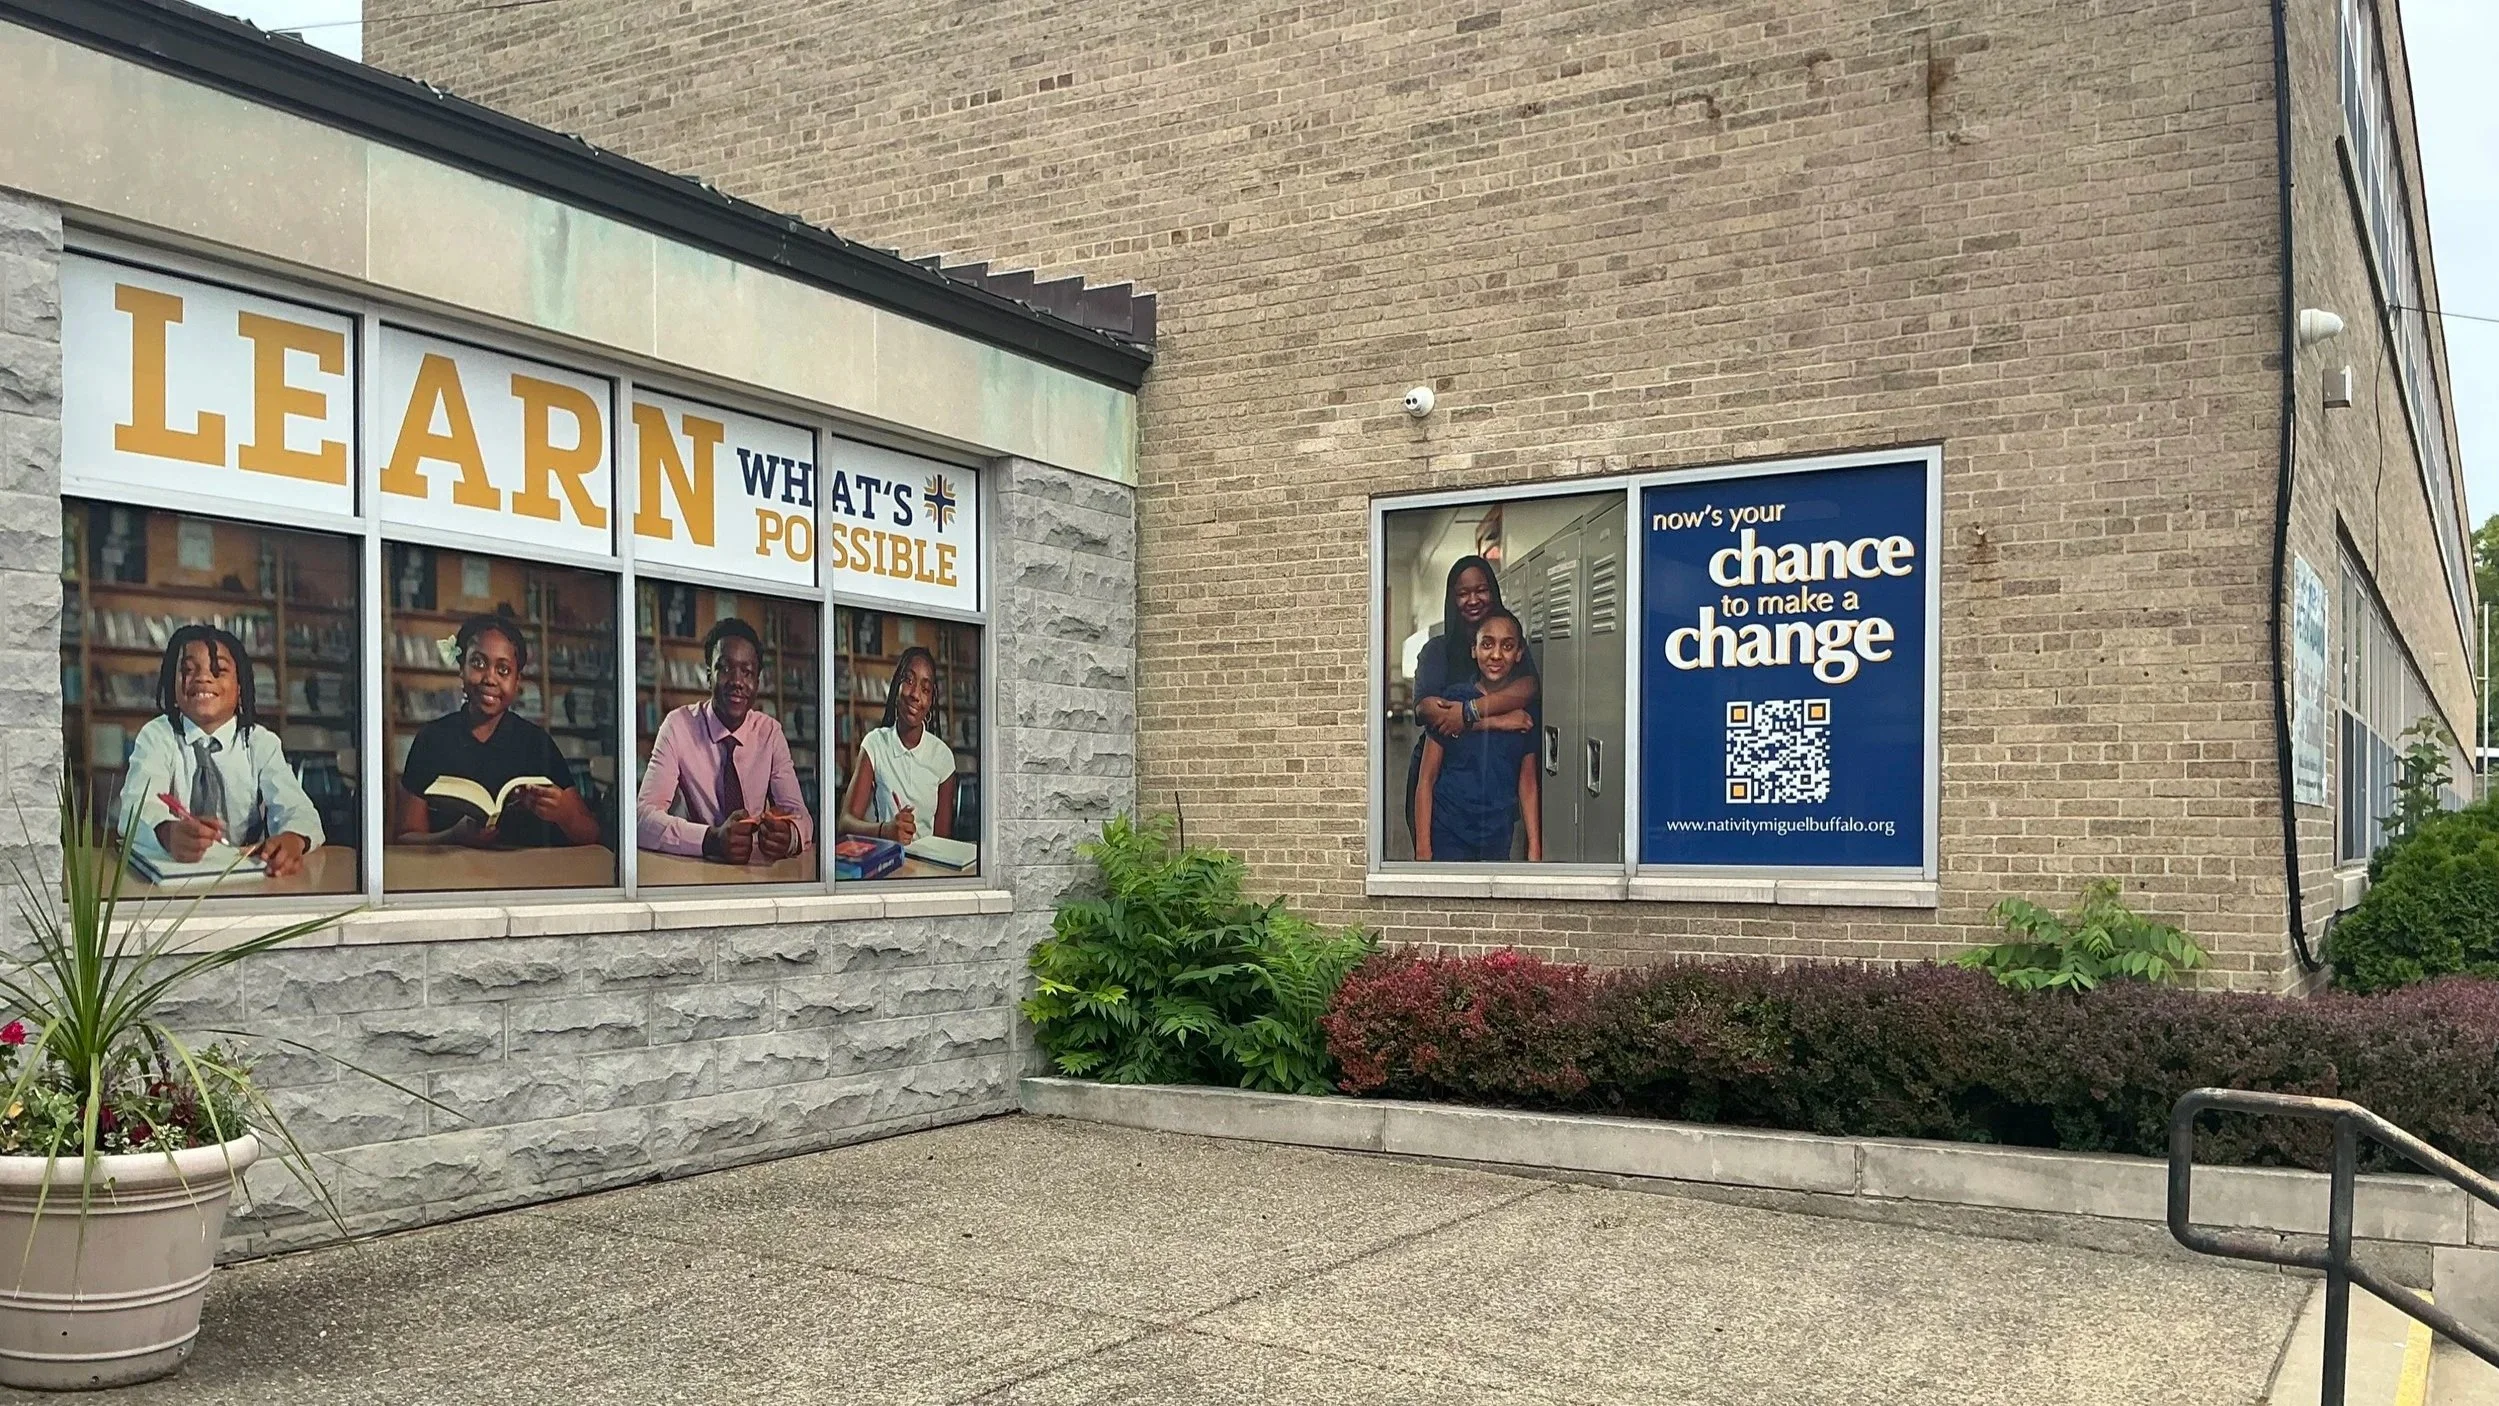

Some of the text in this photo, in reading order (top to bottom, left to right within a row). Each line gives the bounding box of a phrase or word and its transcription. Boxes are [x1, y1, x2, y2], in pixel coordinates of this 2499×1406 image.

[115, 283, 724, 547] LEARN
[736, 447, 913, 527] WHAT'S
[1652, 503, 1786, 532] now's your
[755, 507, 958, 587] POSSIBLE
[1708, 528, 1915, 588] chance
[1721, 585, 1860, 617] to make a
[1664, 606, 1895, 684] change
[1666, 816, 1895, 836] www.nativitymiguelbuffalo.org
